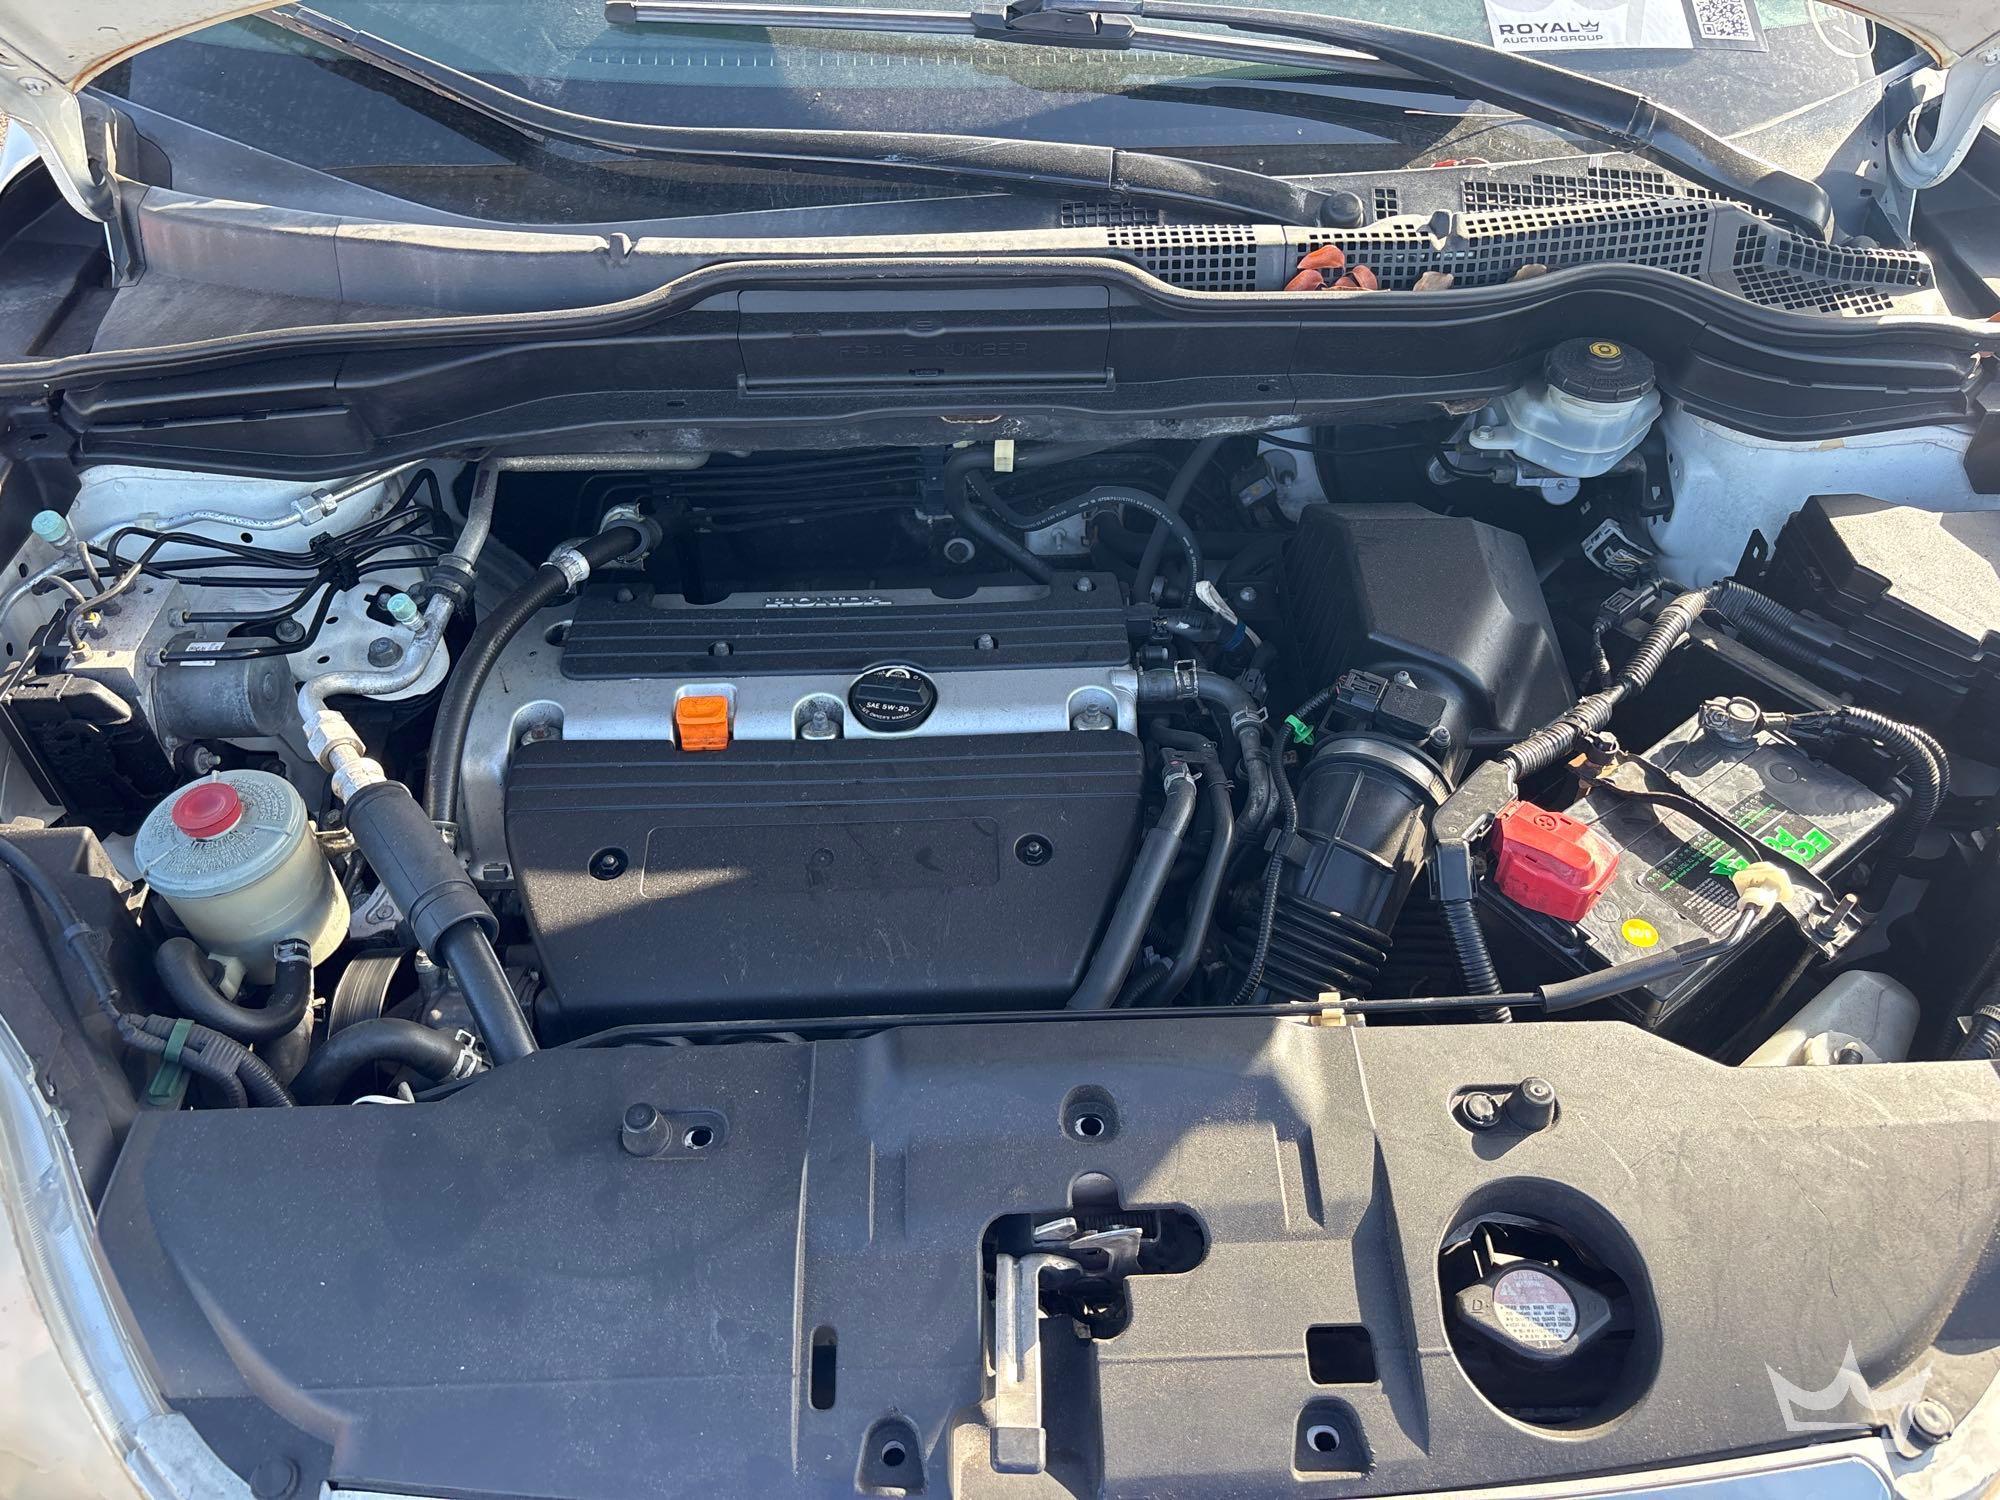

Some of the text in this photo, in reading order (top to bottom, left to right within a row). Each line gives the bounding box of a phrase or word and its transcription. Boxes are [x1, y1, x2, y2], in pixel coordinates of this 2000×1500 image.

[1499, 22, 1580, 35] ROYAL
[1502, 34, 1604, 44] AUCTION GROUP
[839, 342, 1031, 358] FRAME NUMBER
[866, 701, 910, 713] SAE 5W-20
